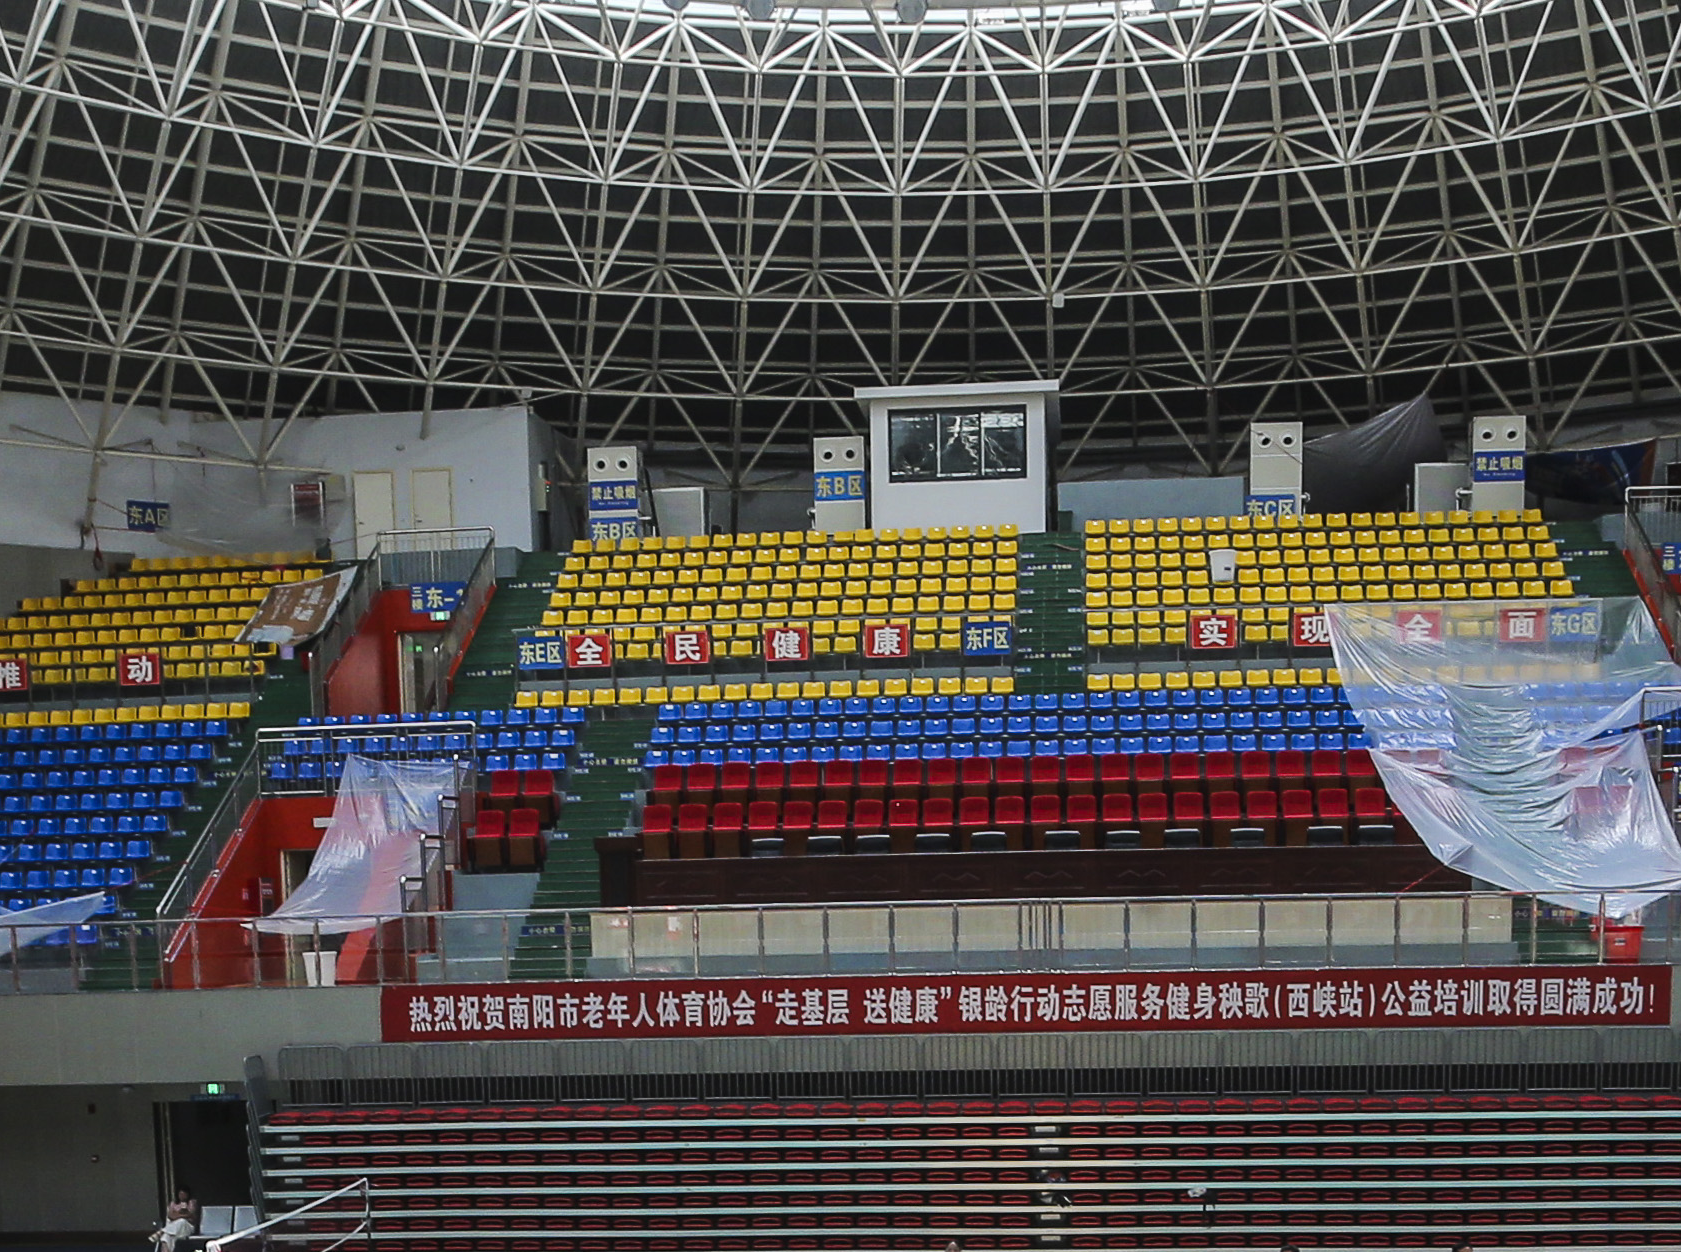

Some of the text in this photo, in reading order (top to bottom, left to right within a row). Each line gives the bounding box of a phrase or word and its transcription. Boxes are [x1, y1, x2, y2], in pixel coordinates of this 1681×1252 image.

[591, 485, 636, 500] 禁止吸烟
[816, 475, 863, 497] 东B区
[128, 505, 171, 527] 东A区
[1247, 499, 1294, 517] 东C区
[591, 521, 637, 541] 东B区
[1198, 611, 1536, 646] 实 现 全 面
[1551, 612, 1597, 636] 东G区
[574, 626, 901, 665] 全 民 健 康
[966, 626, 1009, 650] 东F区
[519, 641, 562, 665] 东E区
[126, 655, 153, 683] 动
